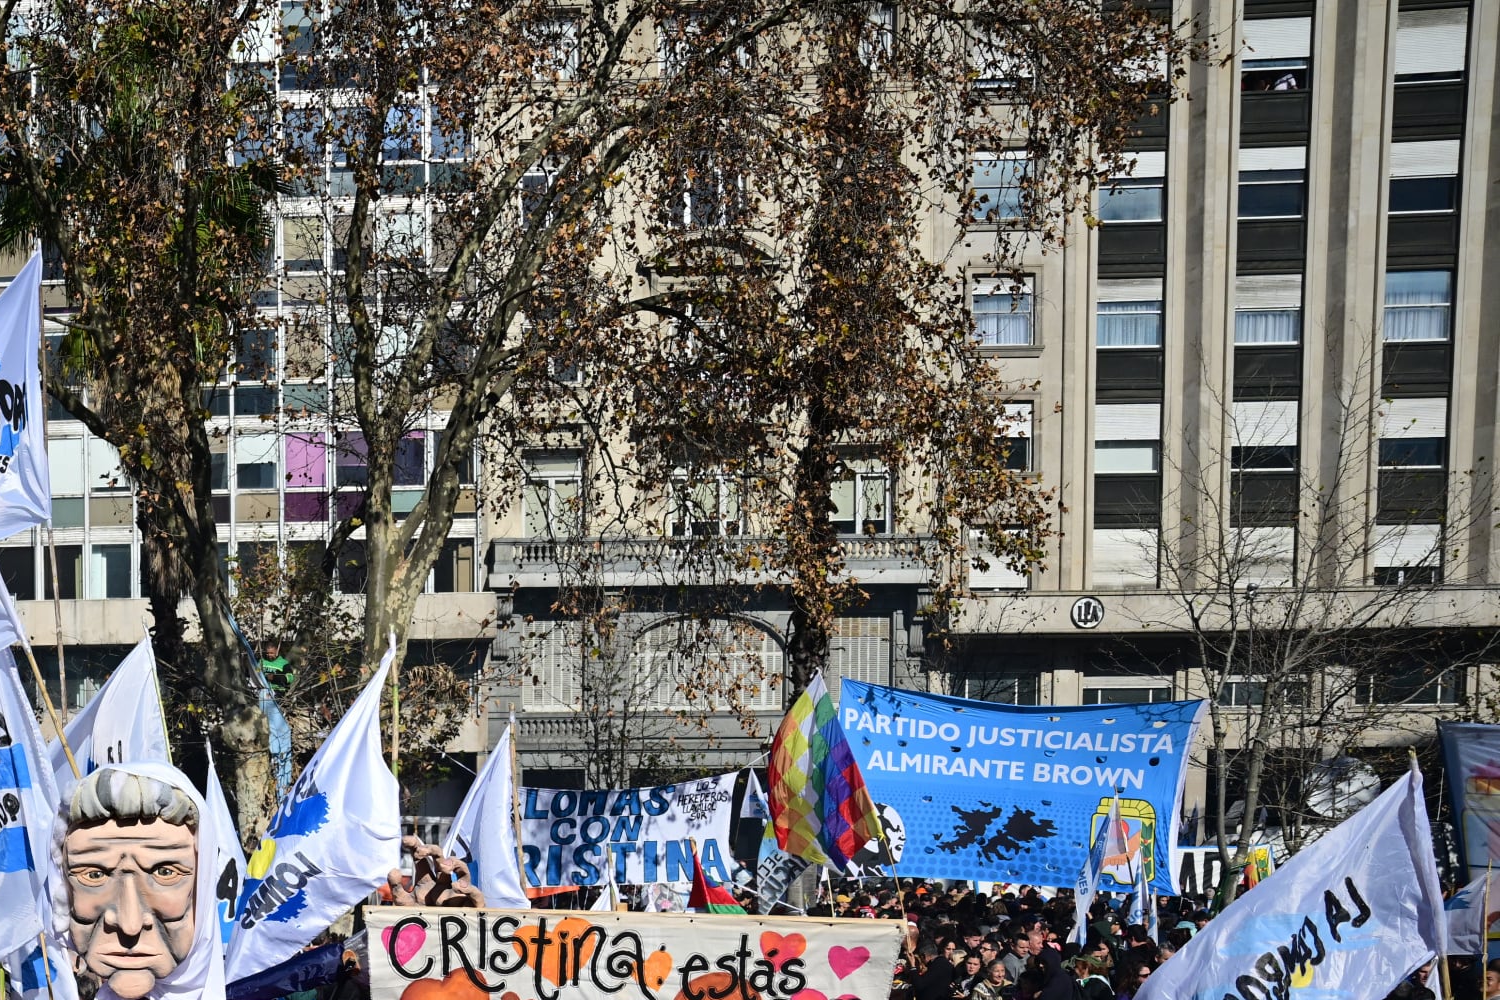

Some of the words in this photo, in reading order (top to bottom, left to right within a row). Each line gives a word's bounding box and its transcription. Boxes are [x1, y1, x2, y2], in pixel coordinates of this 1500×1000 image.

[844, 707, 960, 743] PARTIDO
[966, 723, 1174, 755] JUSTICIALISTA
[866, 749, 1025, 782] ALMIRANTE
[1032, 763, 1145, 790] BROWN
[524, 785, 676, 819] LOMAS
[677, 790, 728, 807] HEREDEROS
[550, 815, 643, 845] CON
[691, 812, 707, 820] SUR
[514, 838, 732, 887] RISTINA
